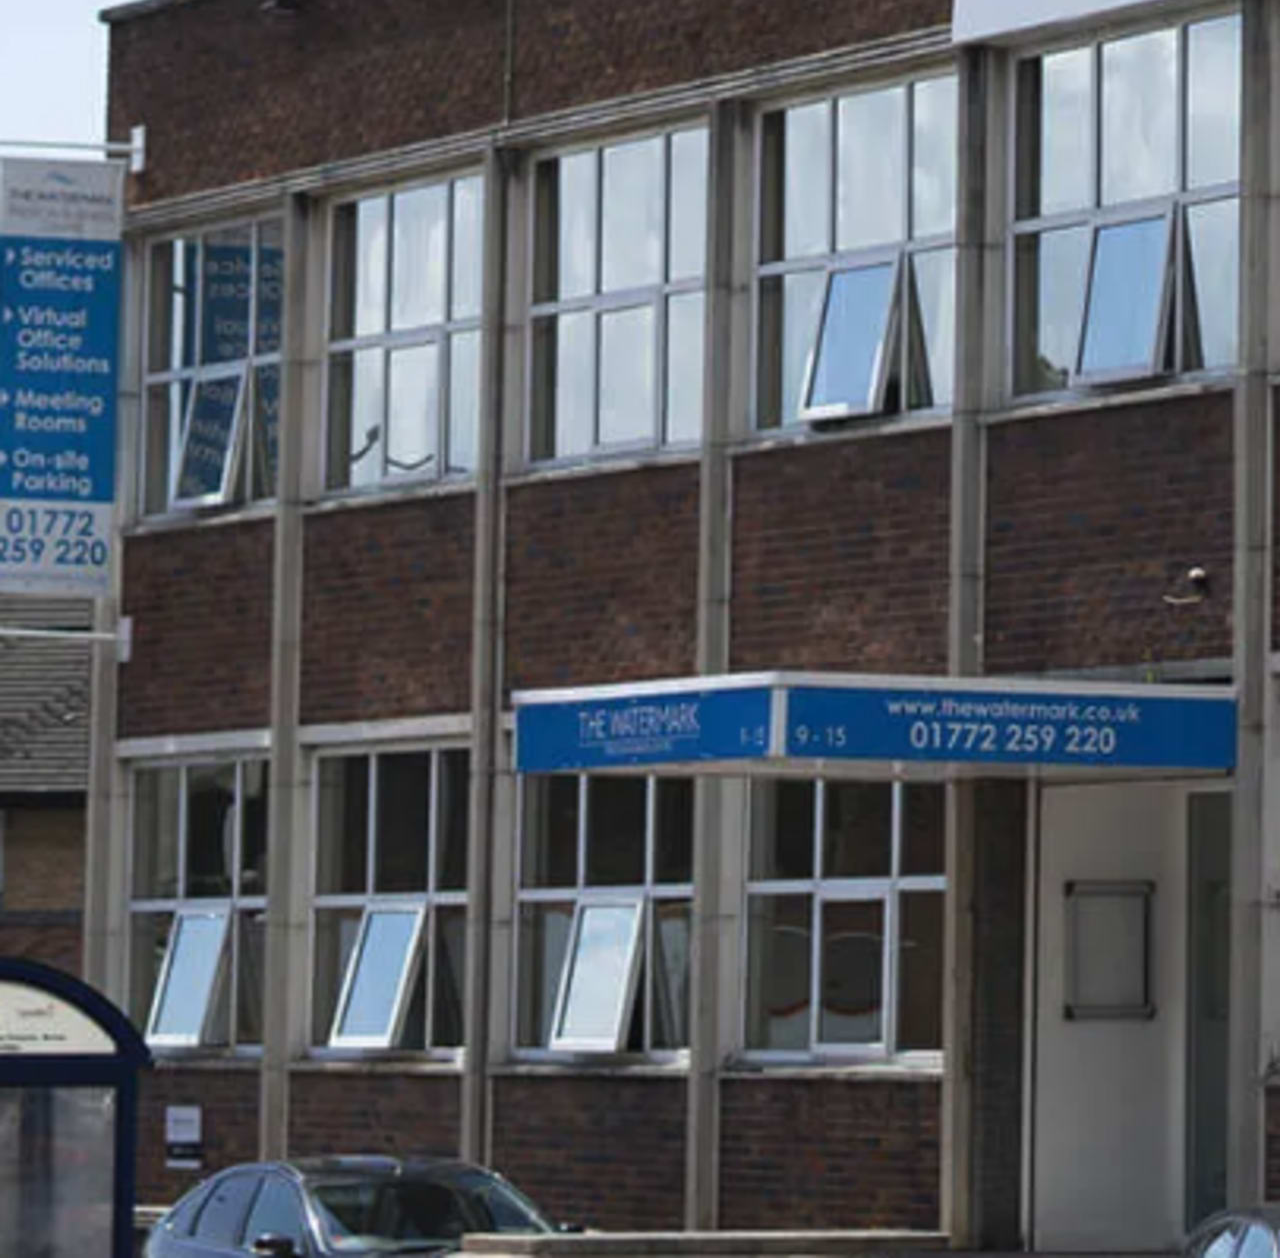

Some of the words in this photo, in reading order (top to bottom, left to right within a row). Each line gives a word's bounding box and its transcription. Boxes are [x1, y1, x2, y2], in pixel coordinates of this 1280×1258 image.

[20, 245, 114, 271] Serviced
[19, 268, 95, 292] Offices
[18, 304, 87, 329] Virtual
[17, 326, 83, 351] Office
[16, 350, 110, 374] Solutions
[14, 389, 105, 416] Meeting
[14, 411, 88, 433] Rooms
[12, 446, 90, 470] On-site
[11, 471, 93, 497] Parking
[6, 506, 95, 537] 01772
[54, 539, 108, 566] 220
[578, 710, 607, 739] THE
[609, 703, 700, 736] WATERMARK
[887, 697, 1141, 723] www.thewatermark.co.uk
[795, 724, 810, 746] 9
[825, 726, 848, 748] 15
[910, 721, 997, 752] 01772
[1005, 723, 1056, 753] 259
[1064, 726, 1117, 755] 220
